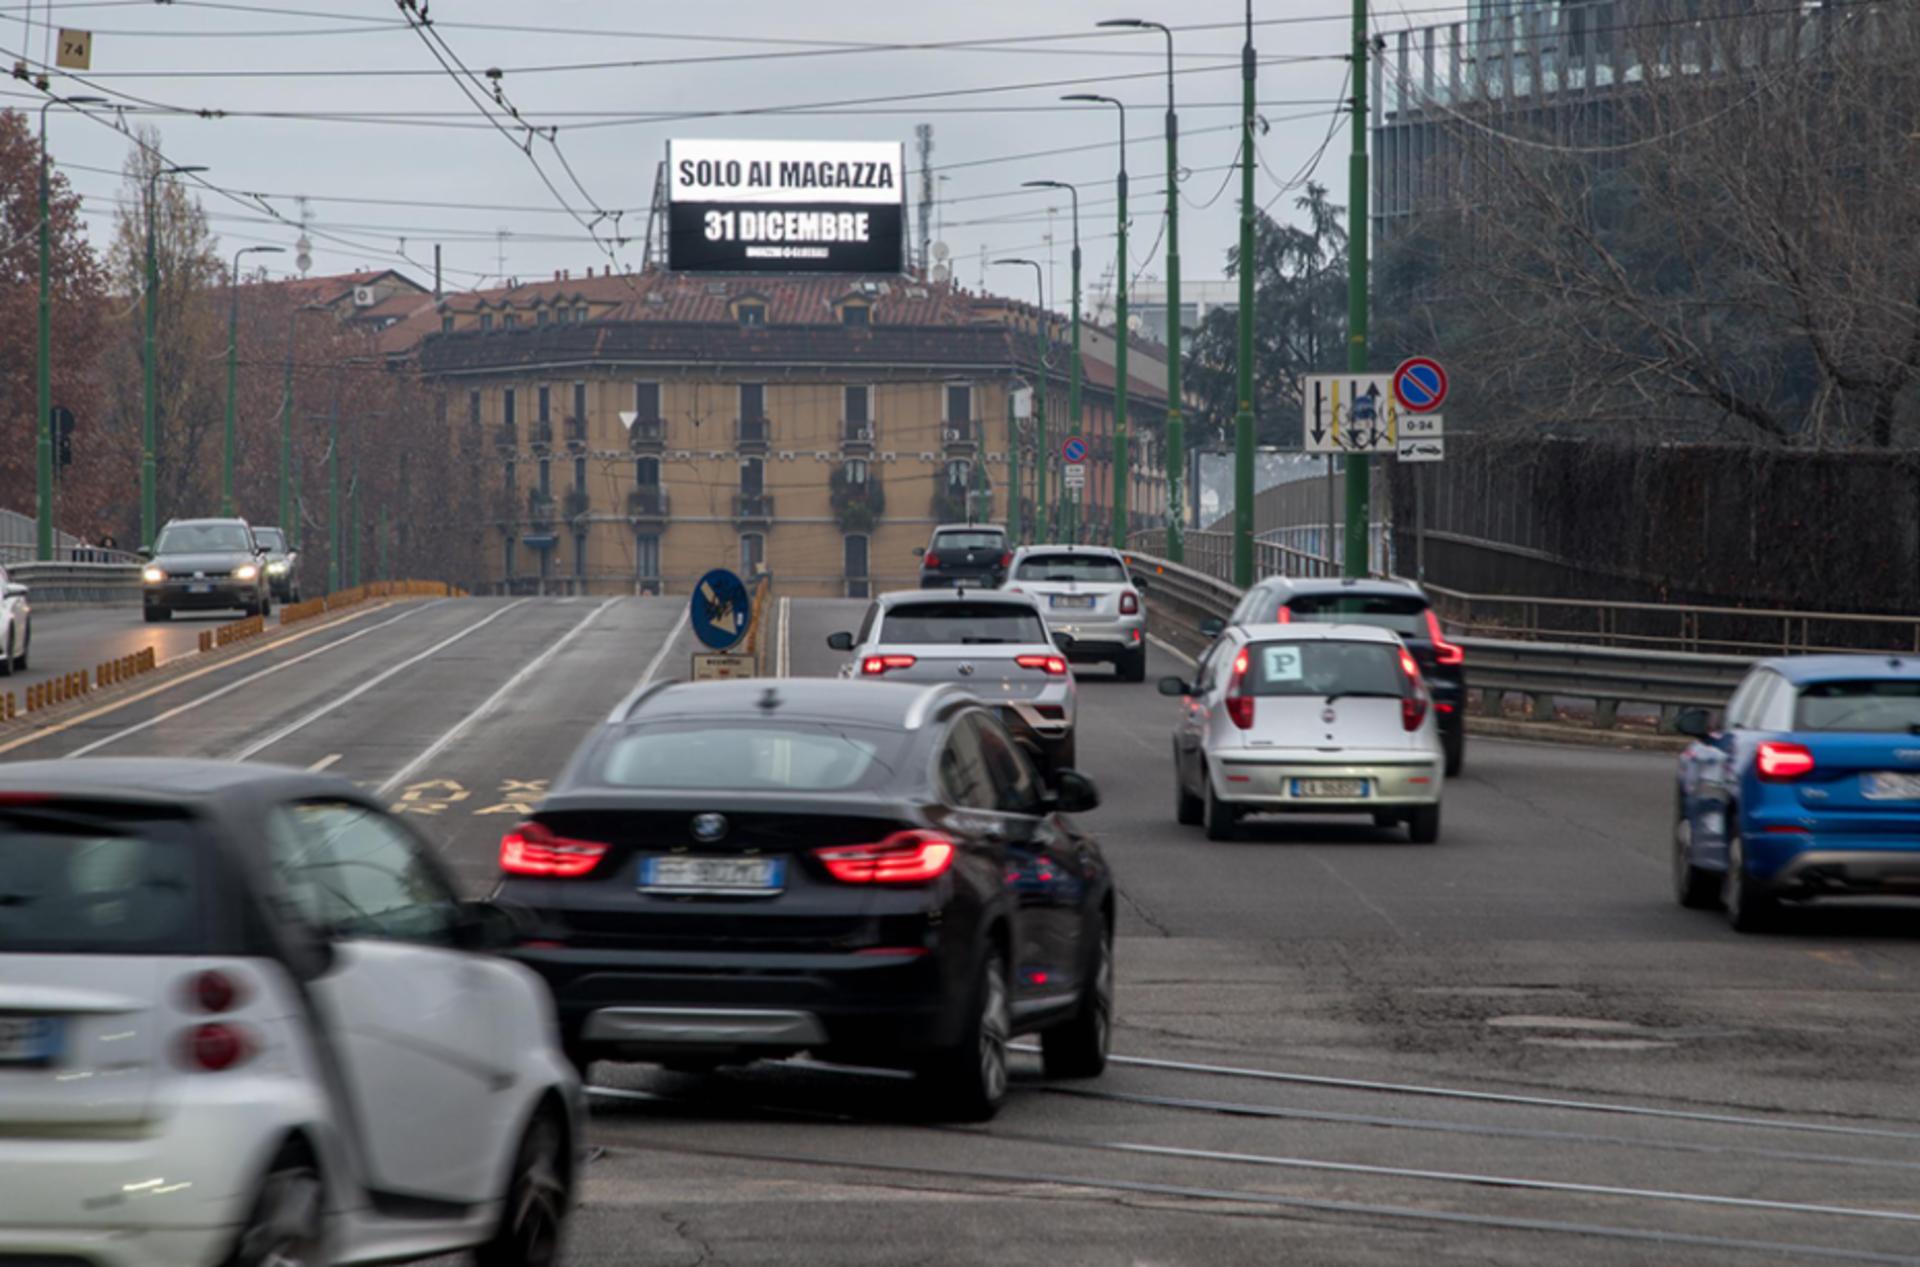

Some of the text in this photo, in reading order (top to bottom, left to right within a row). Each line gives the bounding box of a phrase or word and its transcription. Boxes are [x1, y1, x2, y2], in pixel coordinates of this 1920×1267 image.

[64, 41, 84, 57] 74
[679, 160, 894, 189] SOLO AI MAGAZZA
[704, 210, 869, 242] 31 DICEMBRE
[1271, 653, 1296, 674] P
